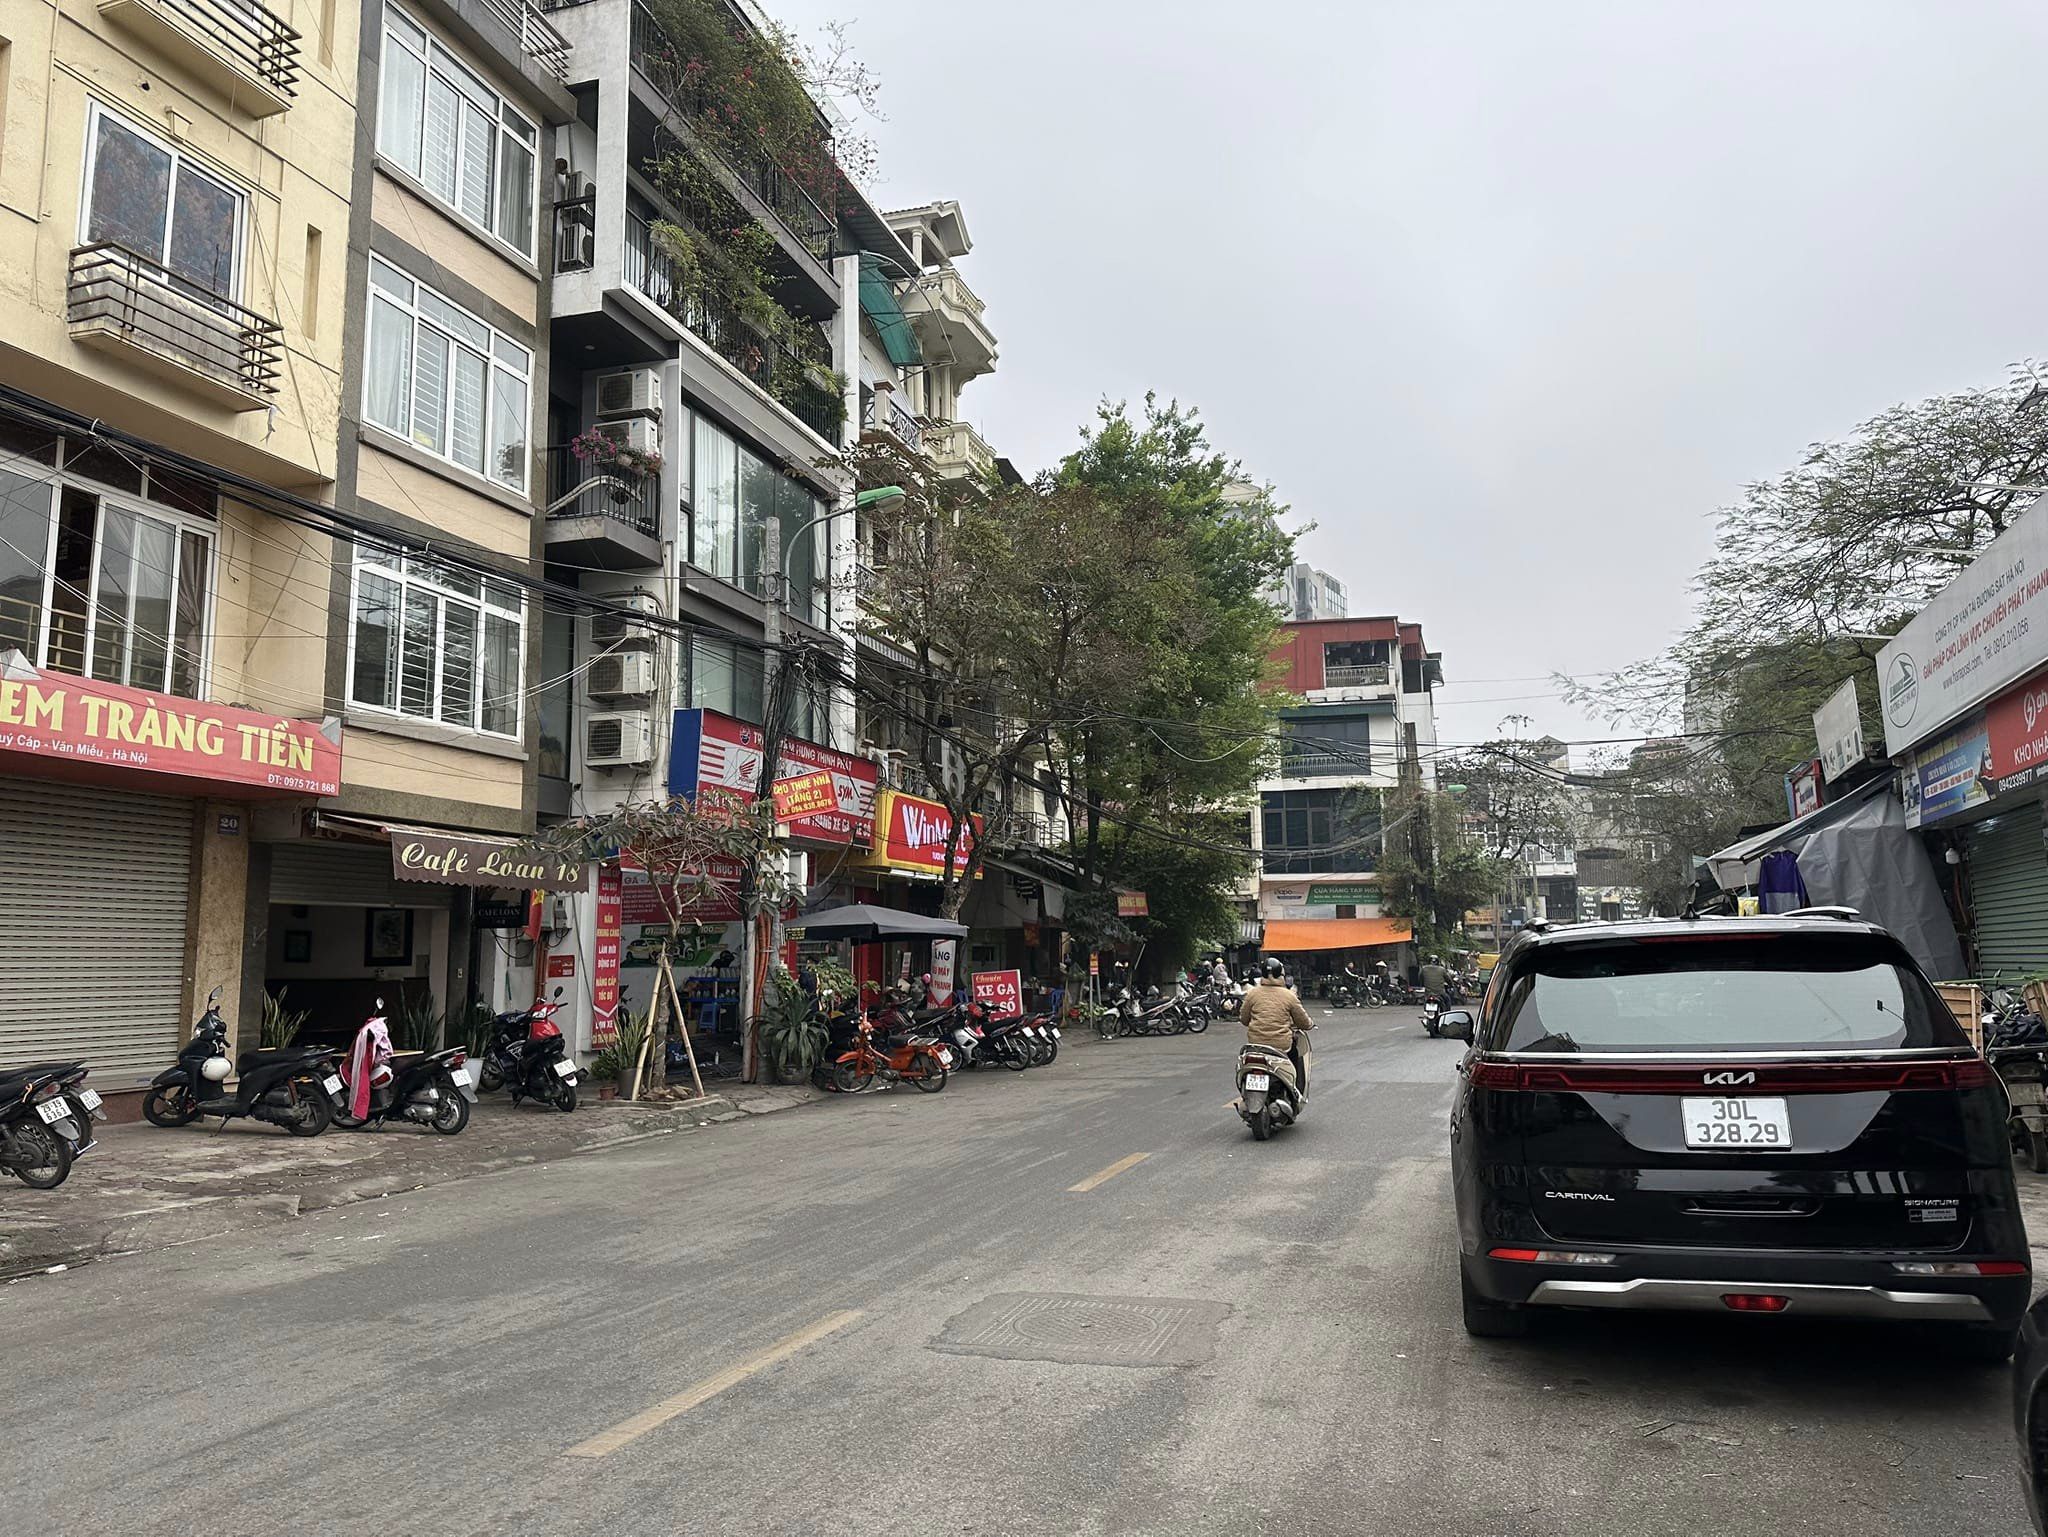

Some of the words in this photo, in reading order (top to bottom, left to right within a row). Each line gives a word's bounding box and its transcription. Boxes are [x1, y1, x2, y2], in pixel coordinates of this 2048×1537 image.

[80, 696, 224, 756] TRÀNG
[237, 719, 314, 772] TIỀN
[17, 734, 41, 751] Cáp
[51, 740, 73, 753] Văn
[76, 743, 103, 758] Miếu
[112, 749, 127, 761] Hà
[130, 751, 148, 765] Nội
[2013, 743, 2031, 766] KHO
[267, 773, 282, 785] ĐT:
[284, 777, 304, 789] 0975
[305, 780, 319, 791] 721
[837, 784, 853, 801] SYM
[220, 818, 238, 829] 20
[832, 816, 841, 831] XE
[841, 818, 851, 833] GA
[401, 842, 470, 877] Café
[476, 851, 547, 881] Loan
[556, 862, 581, 883] 18
[976, 985, 995, 997] XE
[996, 983, 1016, 996] GA
[999, 995, 1016, 1013] SỐ
[1703, 1071, 1756, 1085] KIA
[45, 1106, 68, 1121] 6363
[1711, 1100, 1758, 1120] 30L
[1696, 1122, 1779, 1143] 328.29
[1545, 1191, 1616, 1201] CARNIVAL
